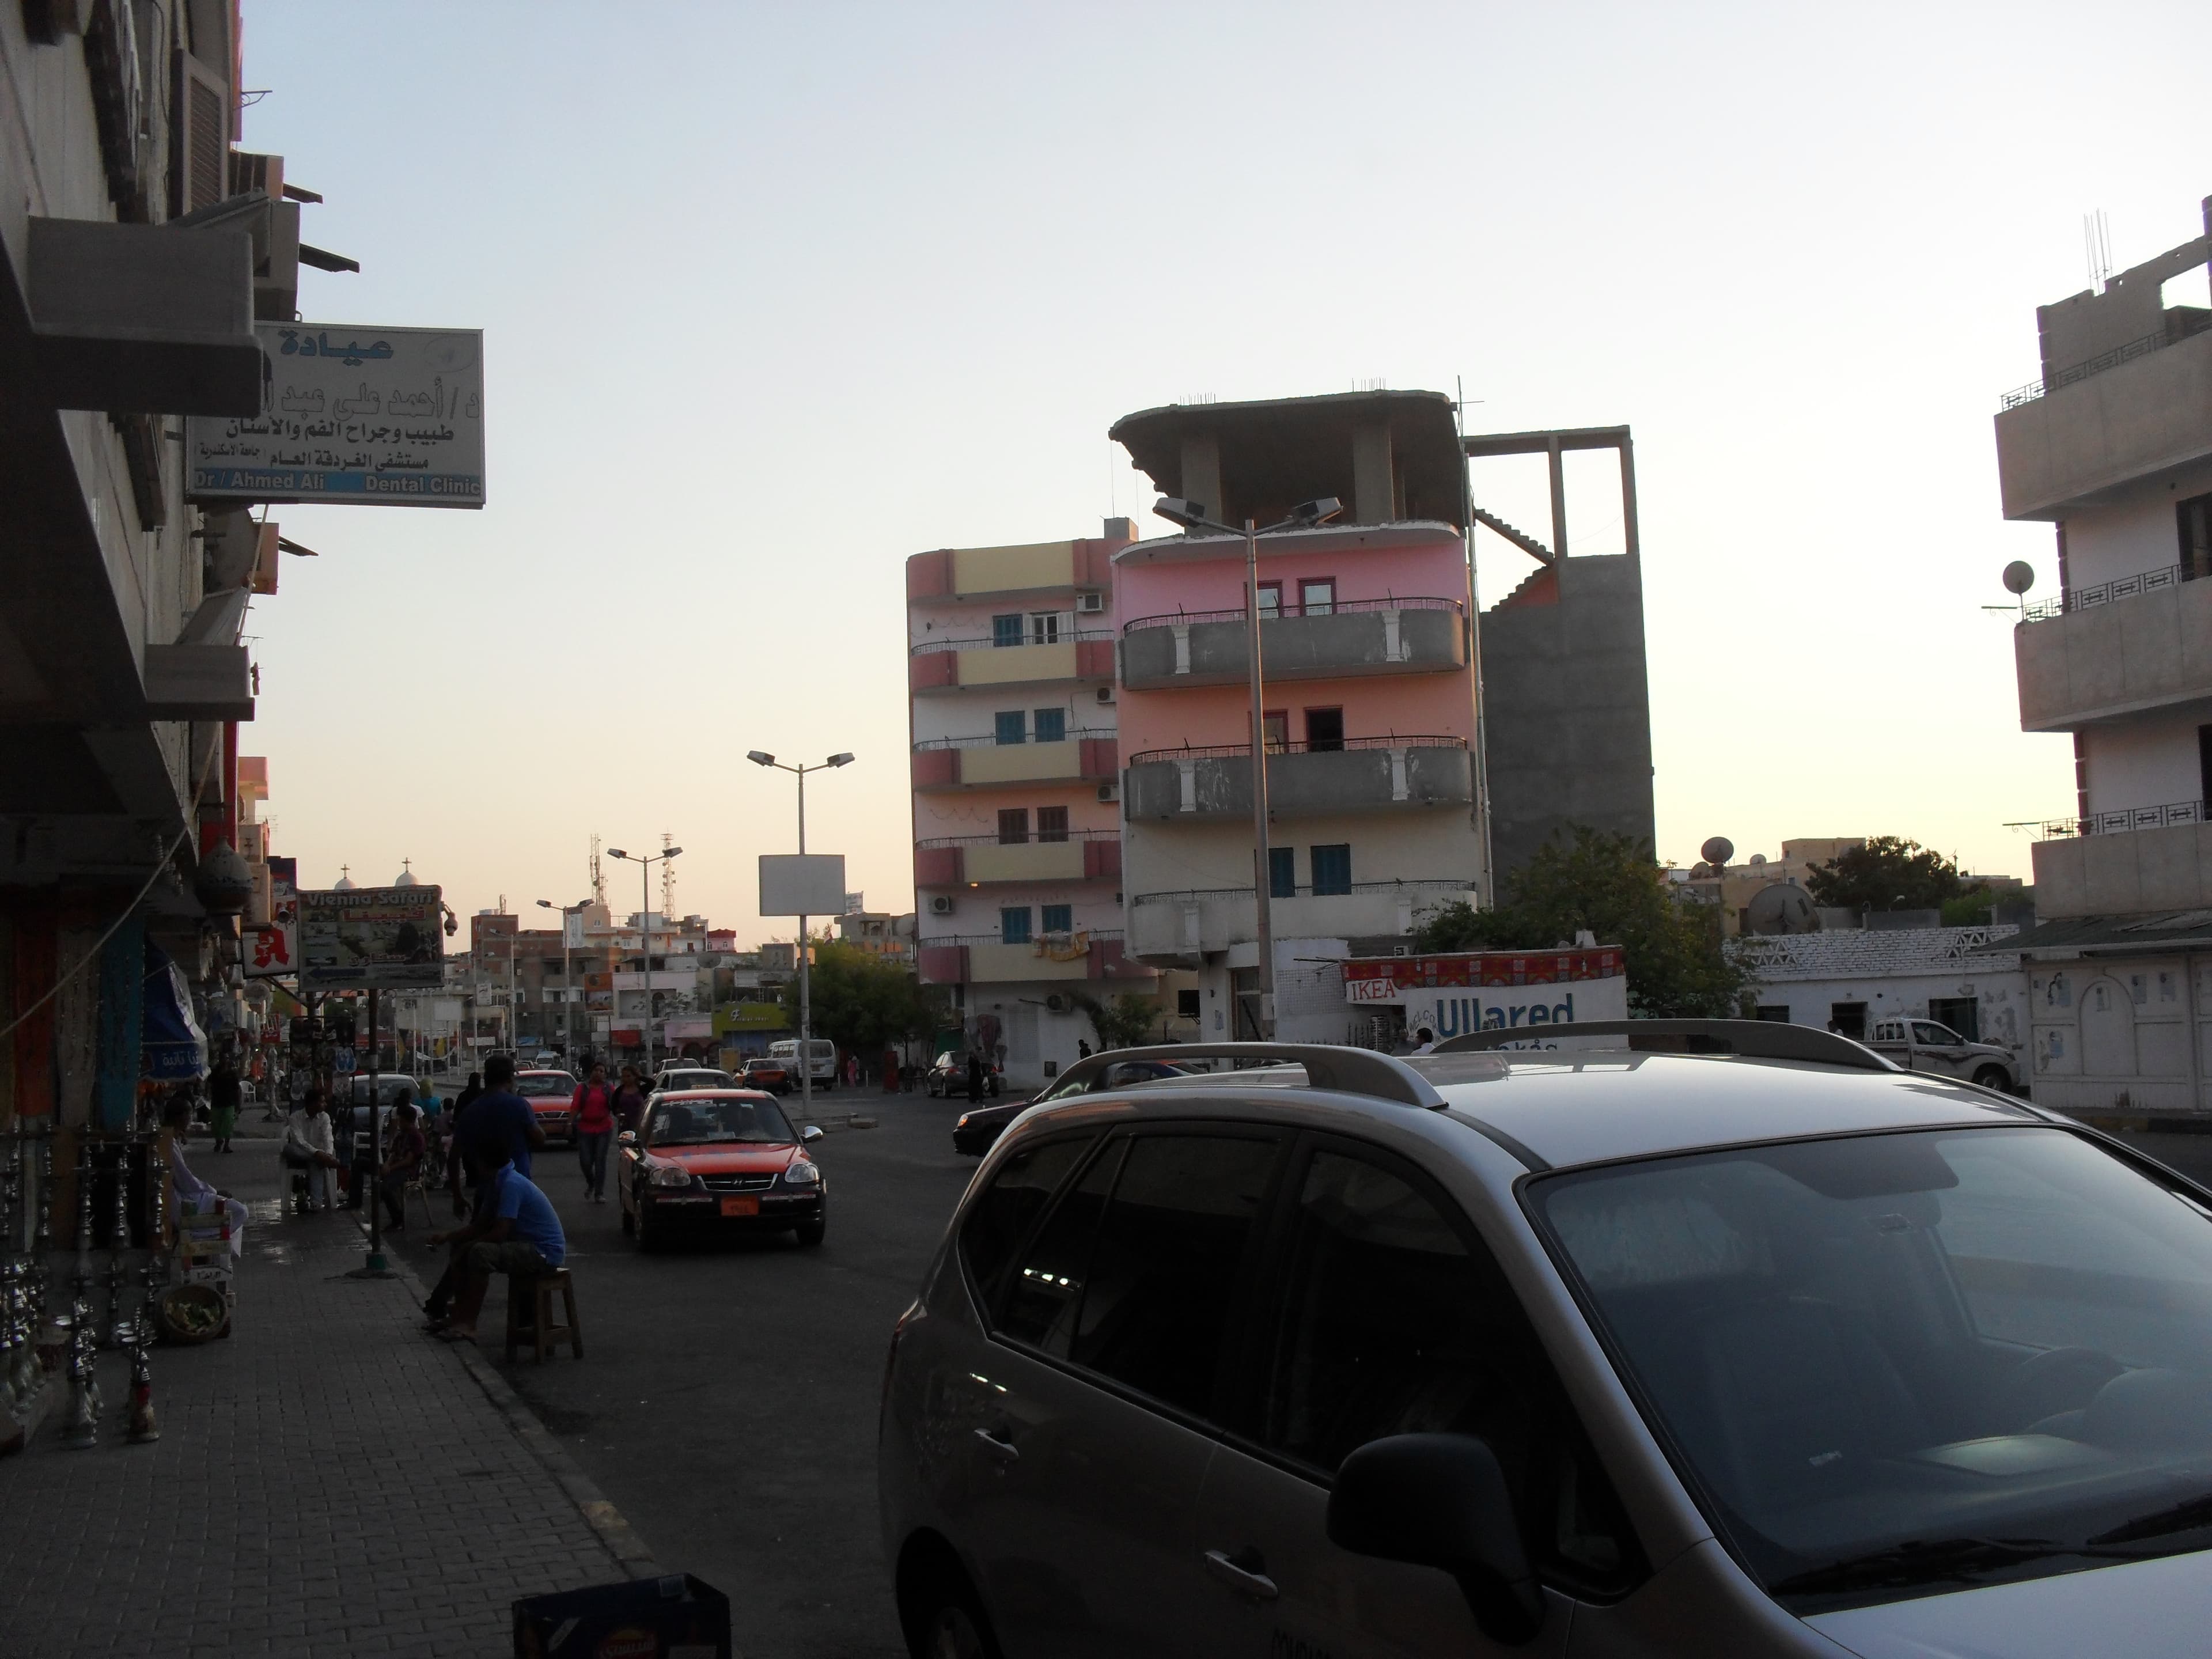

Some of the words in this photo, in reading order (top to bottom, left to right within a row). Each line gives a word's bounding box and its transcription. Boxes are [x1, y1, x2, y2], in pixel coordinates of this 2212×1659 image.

[278, 330, 394, 366] عيادة
[281, 385, 325, 421] عبد
[388, 376, 444, 419] أحمد
[406, 424, 455, 446] طبيب
[270, 452, 311, 468] العام
[315, 450, 372, 471] الغردقة
[195, 471, 215, 488] Dr
[231, 471, 294, 490] Ahmed
[301, 473, 324, 490] Ali
[365, 475, 424, 493] Dental
[430, 476, 481, 495] Clinic
[308, 893, 372, 907] Vienna
[377, 891, 433, 905] Safari
[1352, 979, 1396, 1001] IKEA
[1437, 993, 1574, 1037] Ullared
